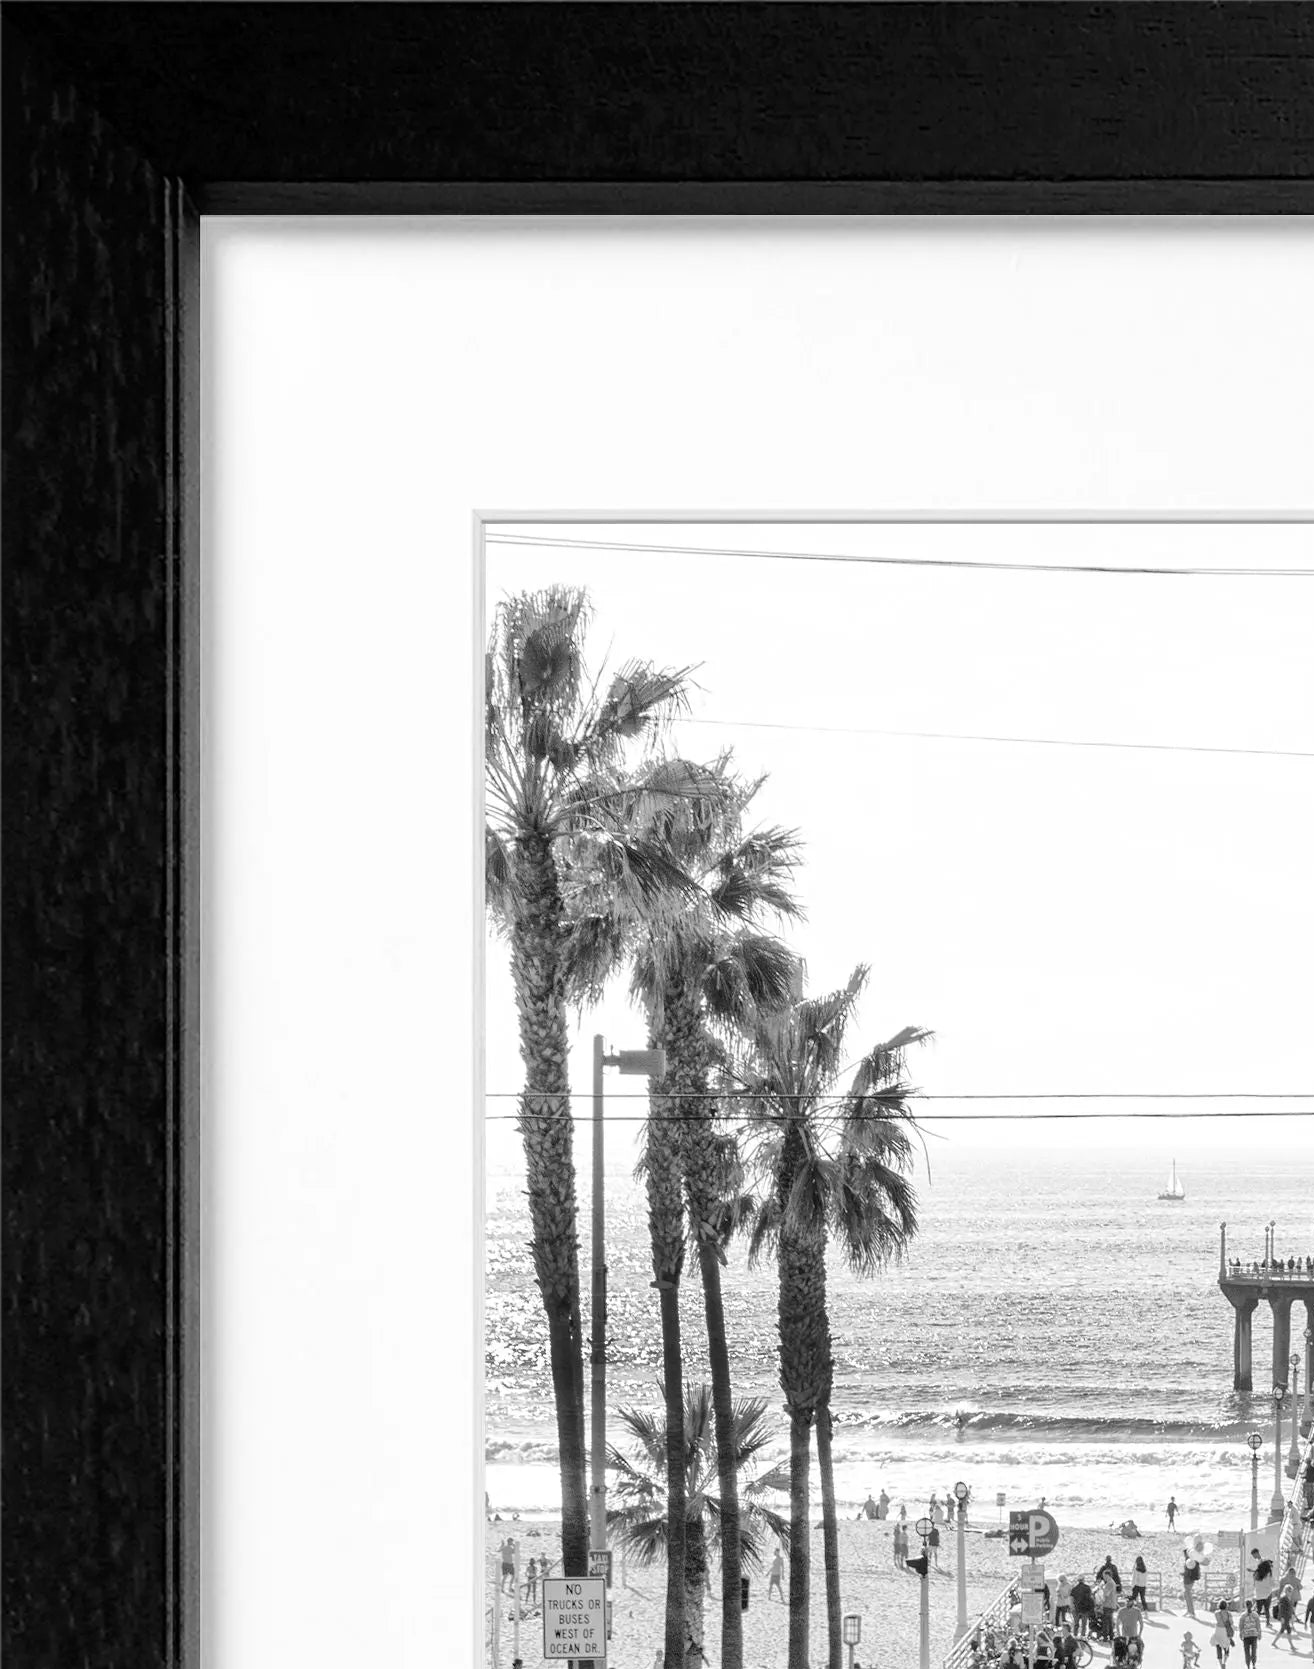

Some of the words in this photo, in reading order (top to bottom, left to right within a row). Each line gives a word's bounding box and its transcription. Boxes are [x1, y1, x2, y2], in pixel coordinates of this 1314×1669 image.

[565, 1584, 582, 1595] NO
[548, 1599, 584, 1610] TRUCKS
[588, 1599, 601, 1610] OR
[559, 1614, 590, 1625] BUSES
[554, 1628, 579, 1639] WEST
[582, 1628, 595, 1639] OF
[549, 1643, 580, 1654] OCEAN
